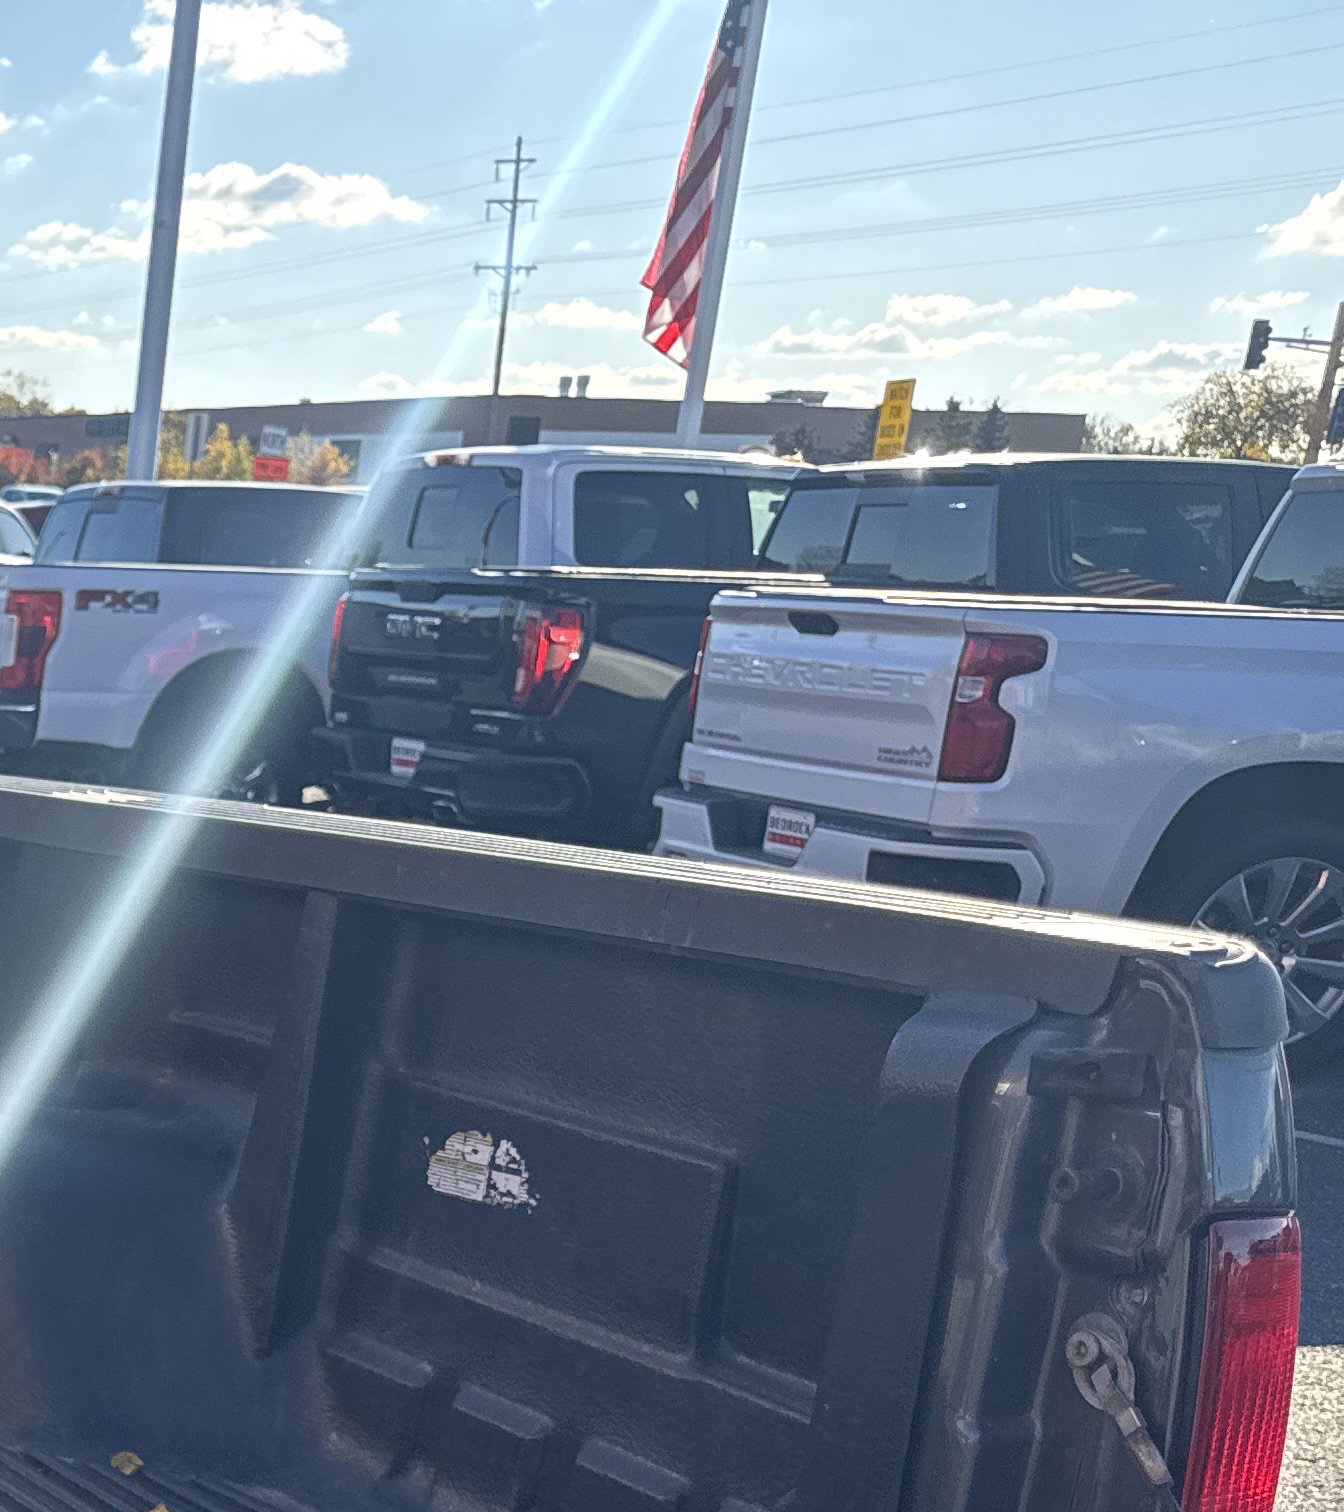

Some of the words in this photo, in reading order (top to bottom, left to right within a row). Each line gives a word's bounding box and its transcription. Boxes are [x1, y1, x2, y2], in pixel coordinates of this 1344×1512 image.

[75, 589, 160, 614] FX4
[386, 613, 442, 640] GMC
[707, 653, 929, 699] CHEVROLET
